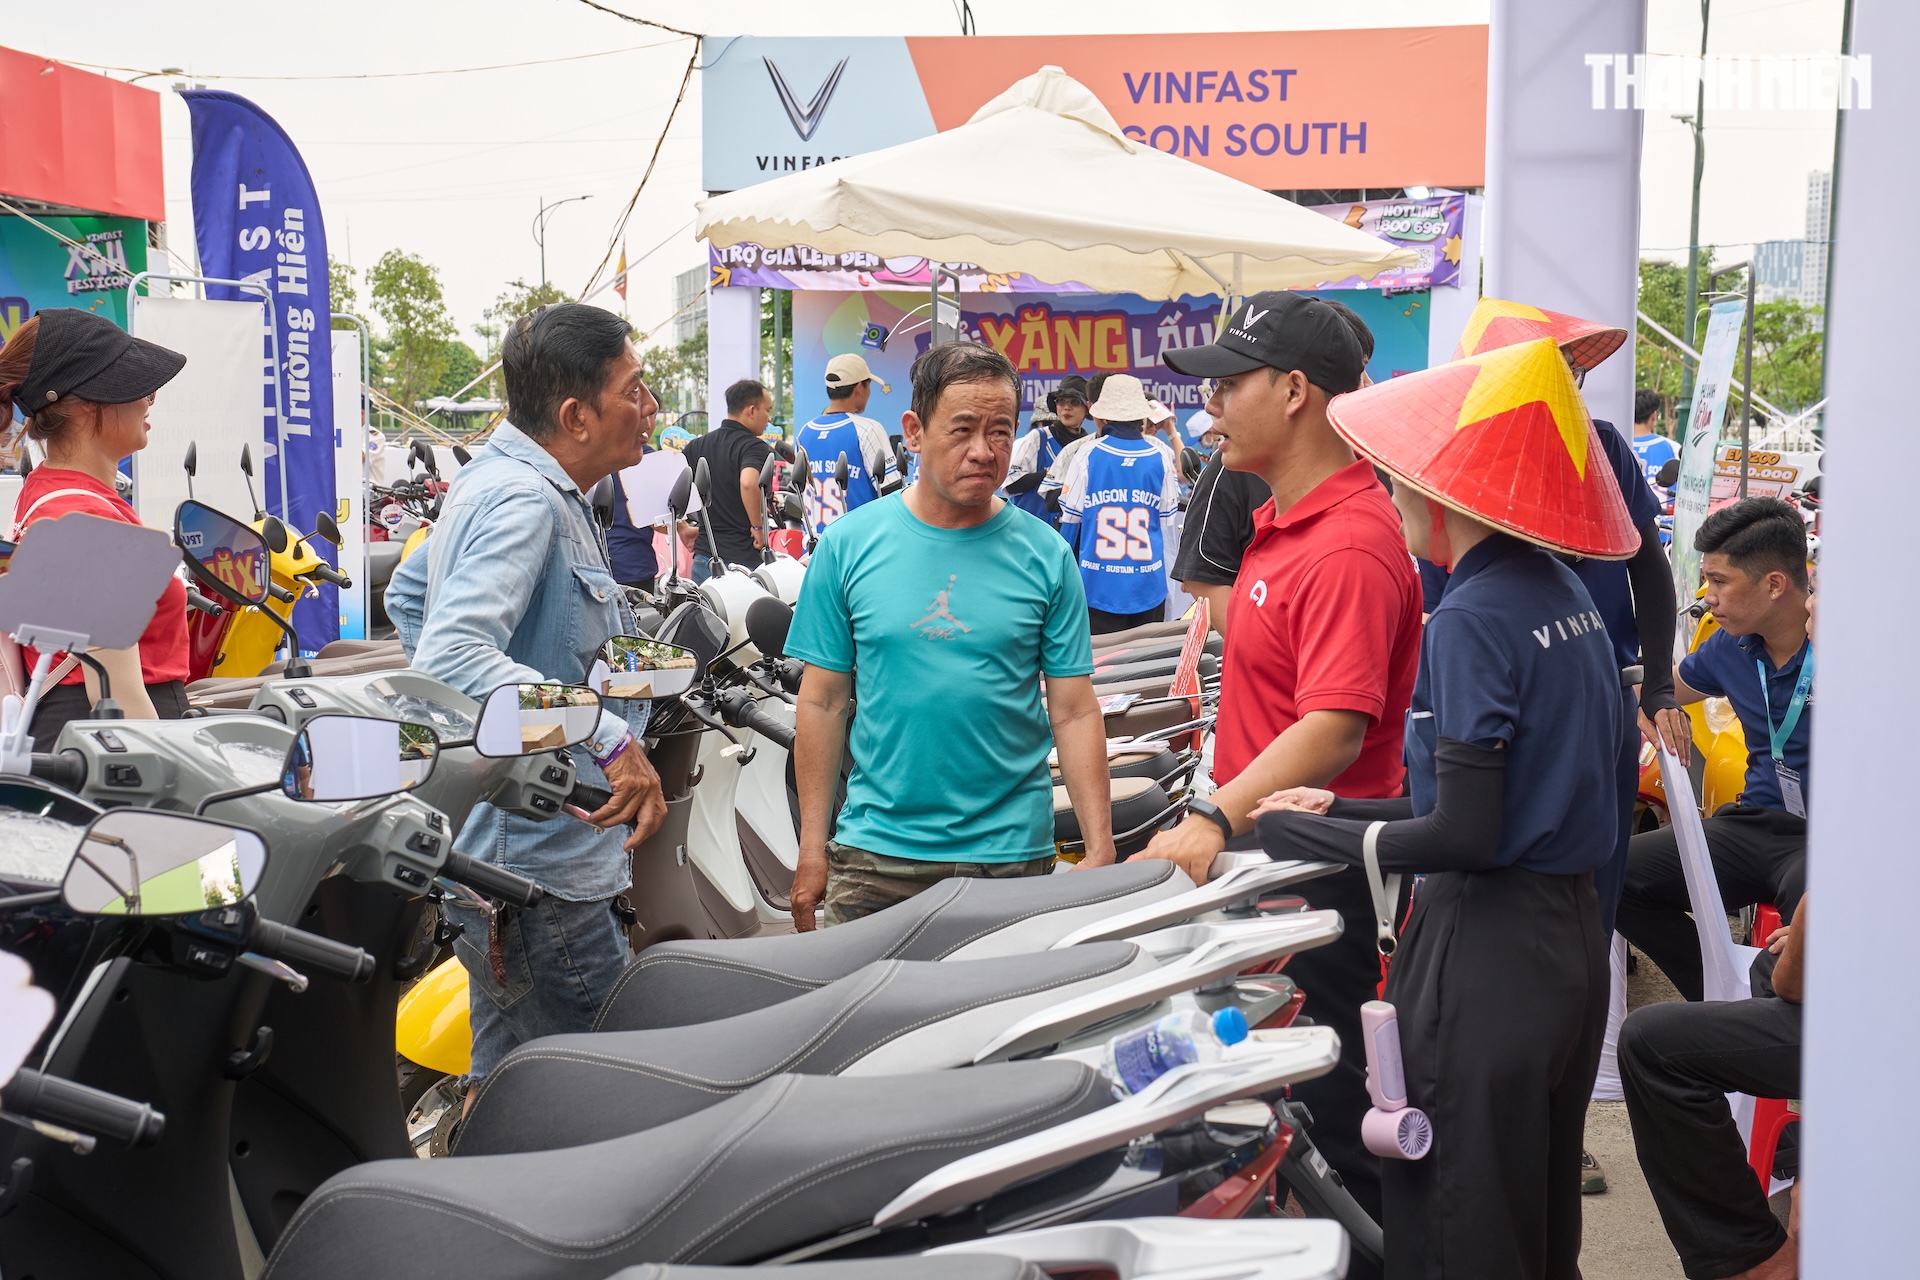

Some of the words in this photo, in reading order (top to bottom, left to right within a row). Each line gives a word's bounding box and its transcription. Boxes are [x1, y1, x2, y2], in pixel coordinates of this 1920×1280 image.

[1123, 69, 1297, 104] VINFAST
[1224, 121, 1367, 156] SOUTH
[1384, 205, 1440, 219] HOTLINE
[1374, 219, 1411, 233] 1800
[1413, 221, 1450, 235] 6967
[979, 311, 1128, 372] XĂNG
[1229, 328, 1258, 343] VINFAST
[282, 306, 316, 441] Trường
[1085, 488, 1128, 509] SAIGON
[1095, 506, 1153, 561] SS
[1105, 564, 1135, 574] SUSTAIN
